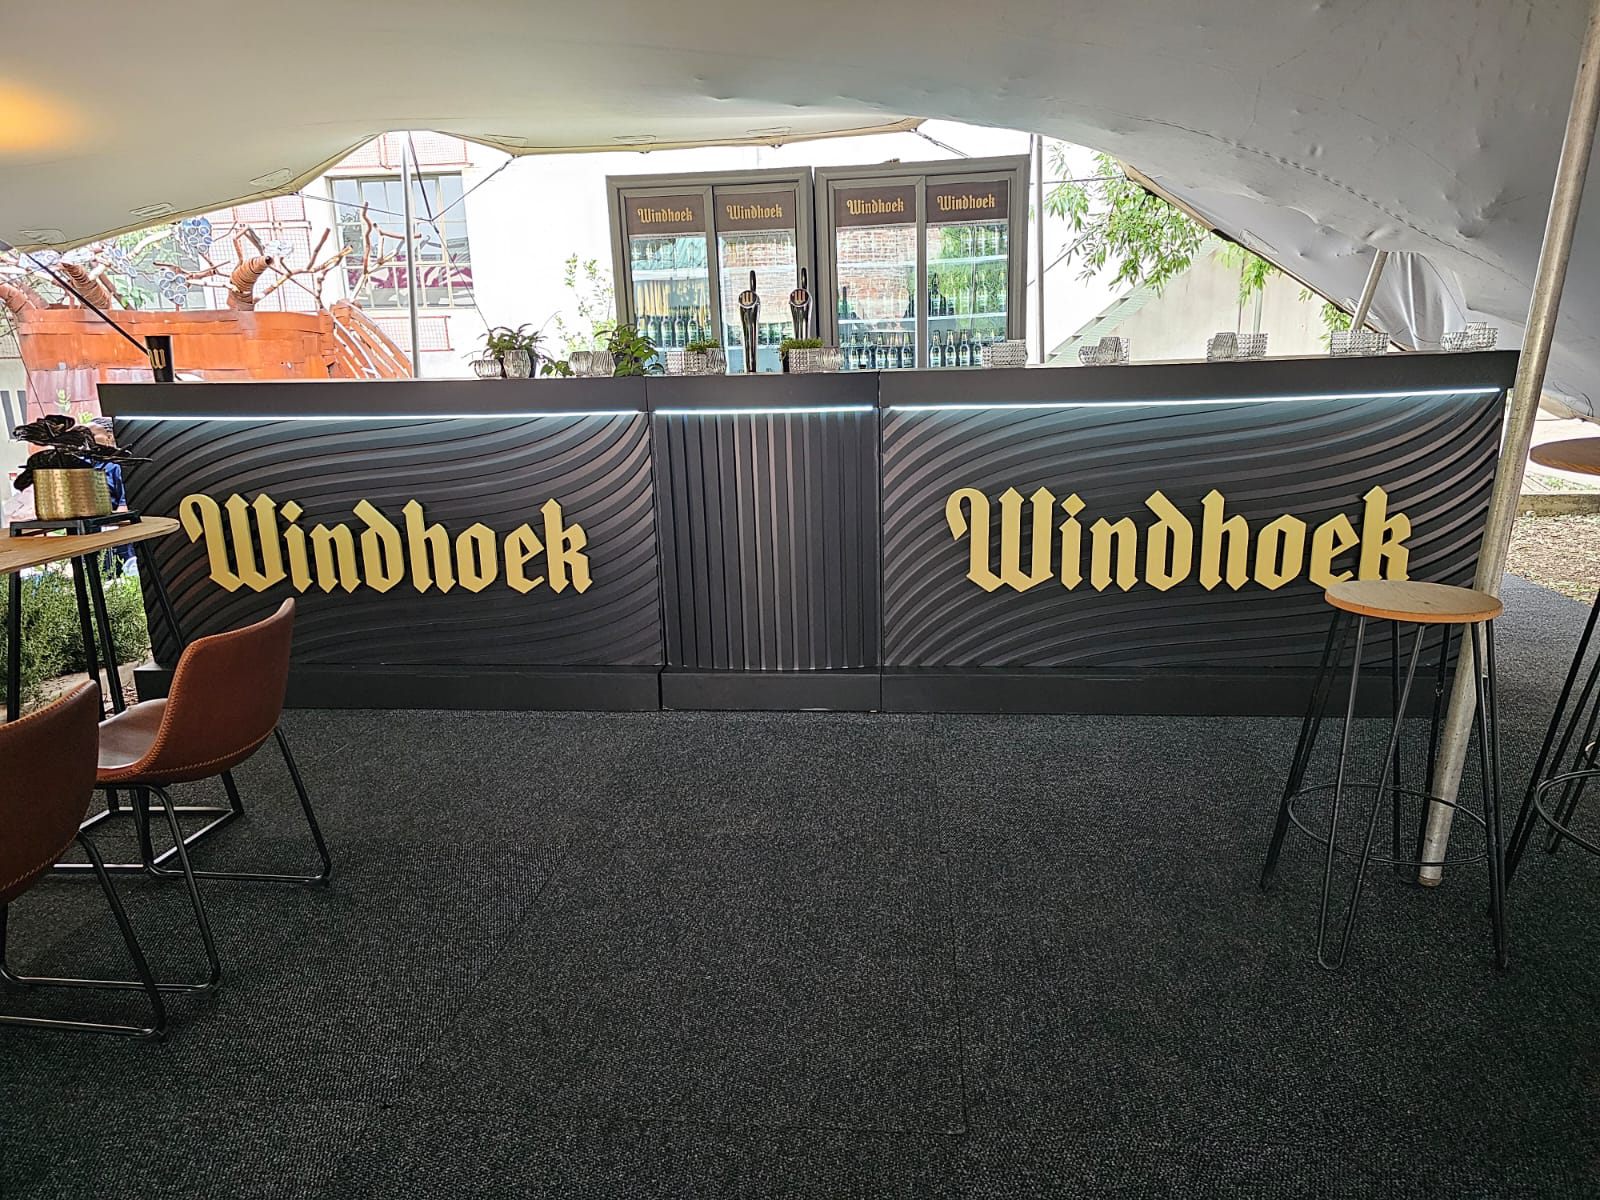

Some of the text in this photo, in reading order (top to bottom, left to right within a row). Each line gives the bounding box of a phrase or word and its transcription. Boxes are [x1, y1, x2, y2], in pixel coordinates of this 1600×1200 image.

[847, 197, 904, 215] Windhoek
[937, 194, 995, 211] Windhoek
[637, 207, 693, 224] Windhoek
[726, 204, 783, 220] Windhoek
[179, 493, 592, 594] Windhoek
[945, 485, 1412, 592] Windhoek
